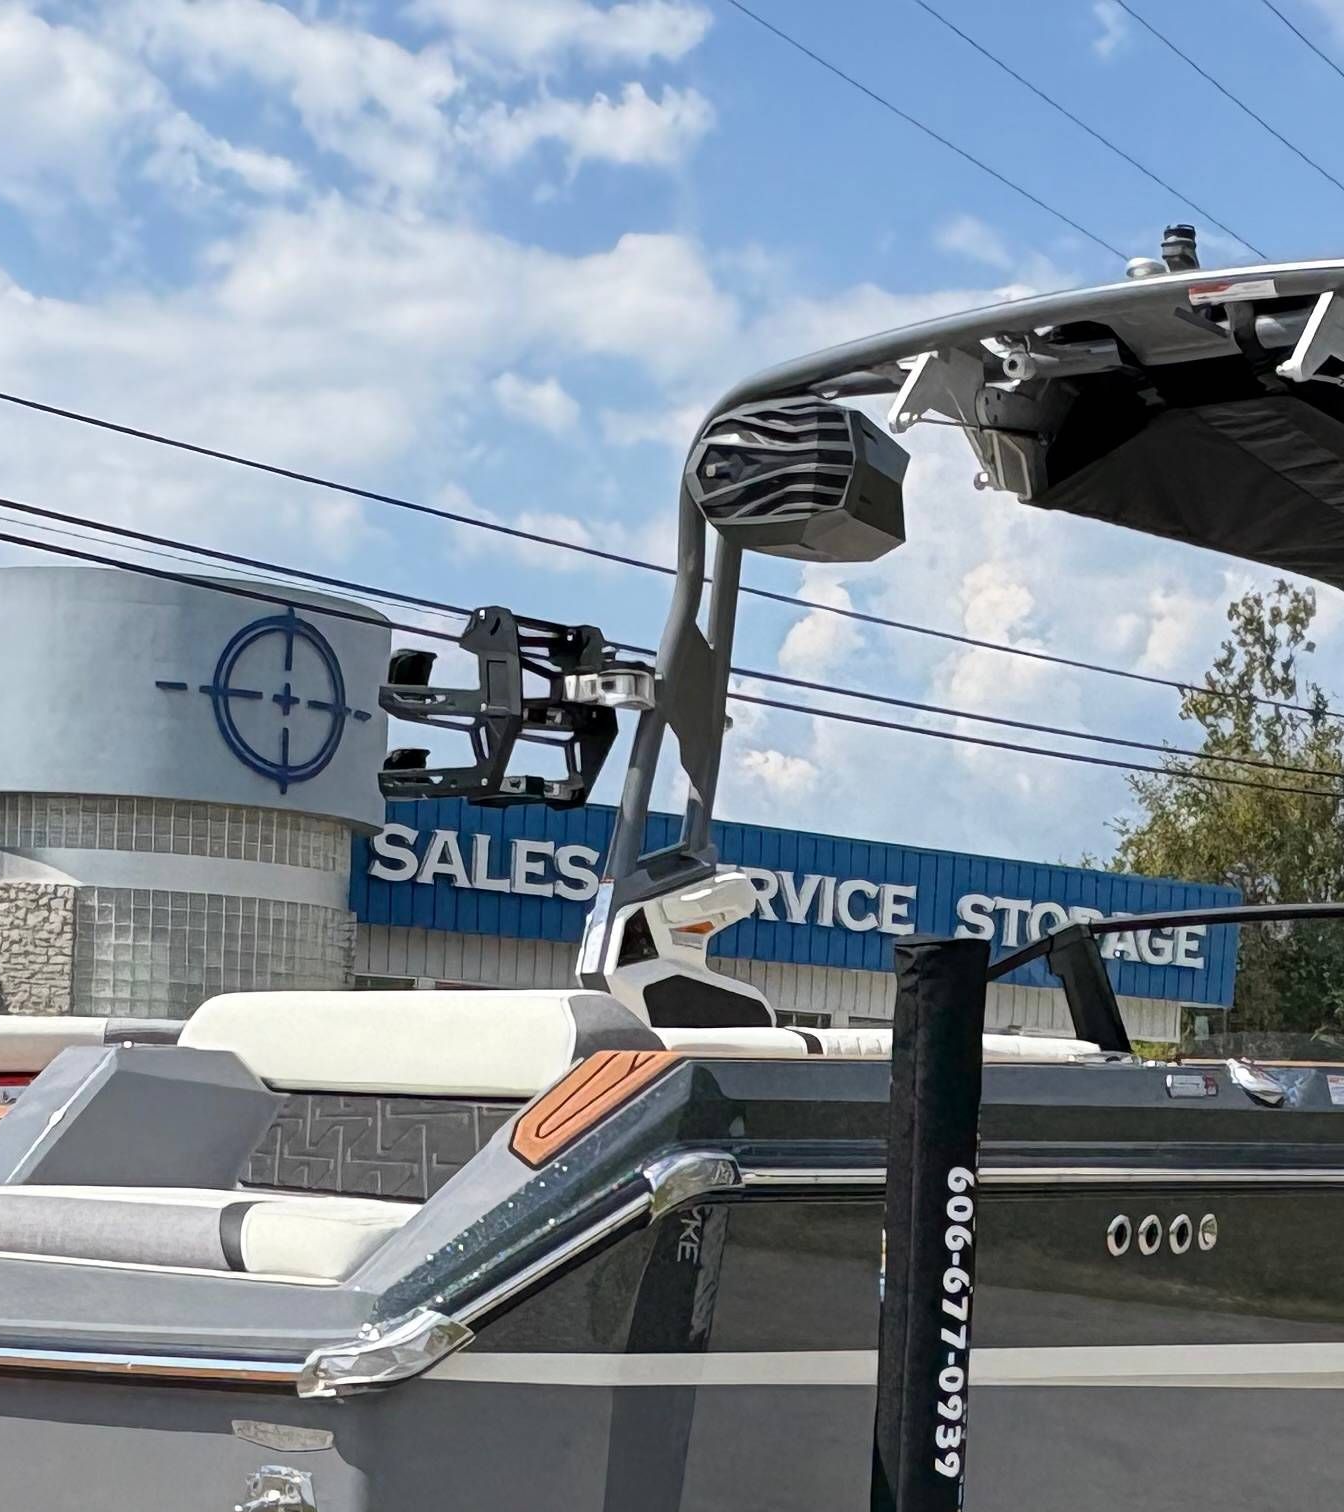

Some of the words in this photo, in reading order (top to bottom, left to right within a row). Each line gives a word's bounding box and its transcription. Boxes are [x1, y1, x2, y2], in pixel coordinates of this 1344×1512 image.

[368, 823, 601, 902] SALES
[716, 863, 917, 936] RVICE
[934, 1165, 975, 1479] 606-677-0939
